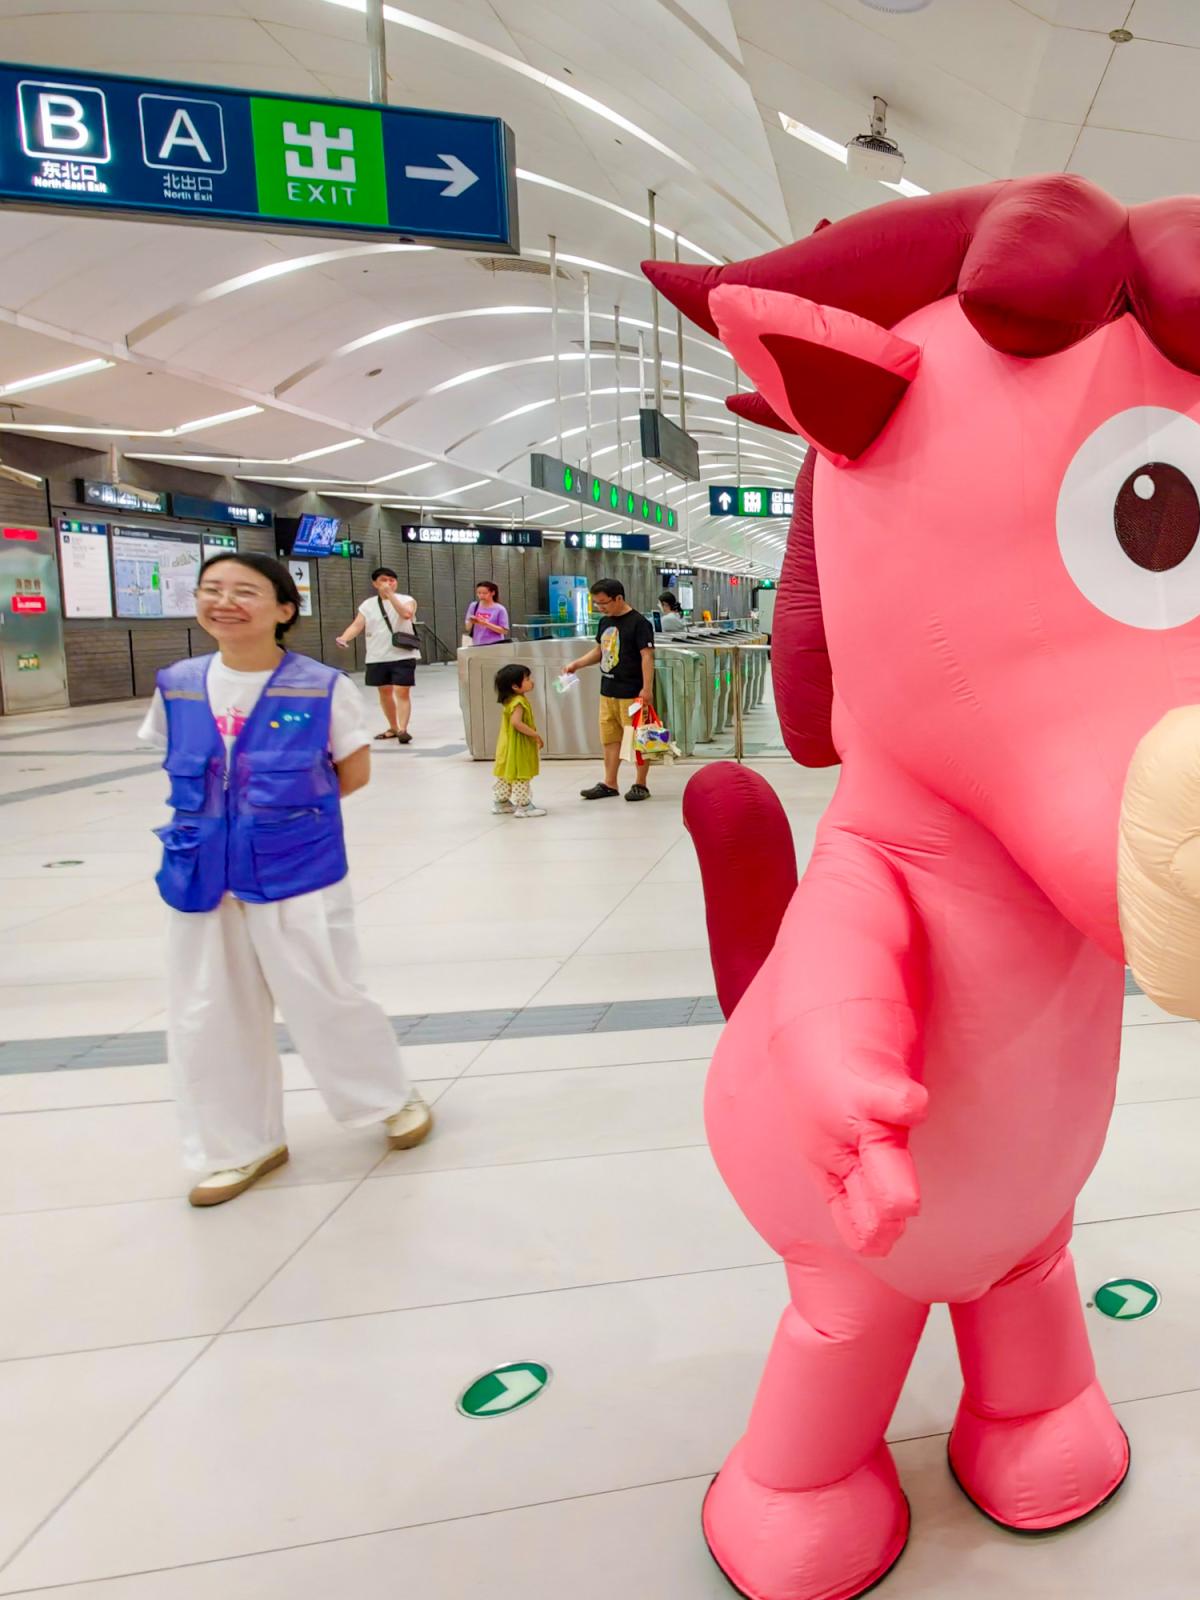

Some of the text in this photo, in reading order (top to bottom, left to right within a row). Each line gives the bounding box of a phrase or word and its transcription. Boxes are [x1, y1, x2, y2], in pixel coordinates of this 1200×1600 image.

[38, 92, 89, 150] B
[158, 108, 212, 163] A
[283, 121, 357, 183] 出
[42, 160, 98, 181] 东北口
[33, 175, 108, 193] North-East Exit
[163, 173, 213, 191] 北出口
[163, 189, 213, 202] North Exit
[287, 182, 357, 206] EXIT
